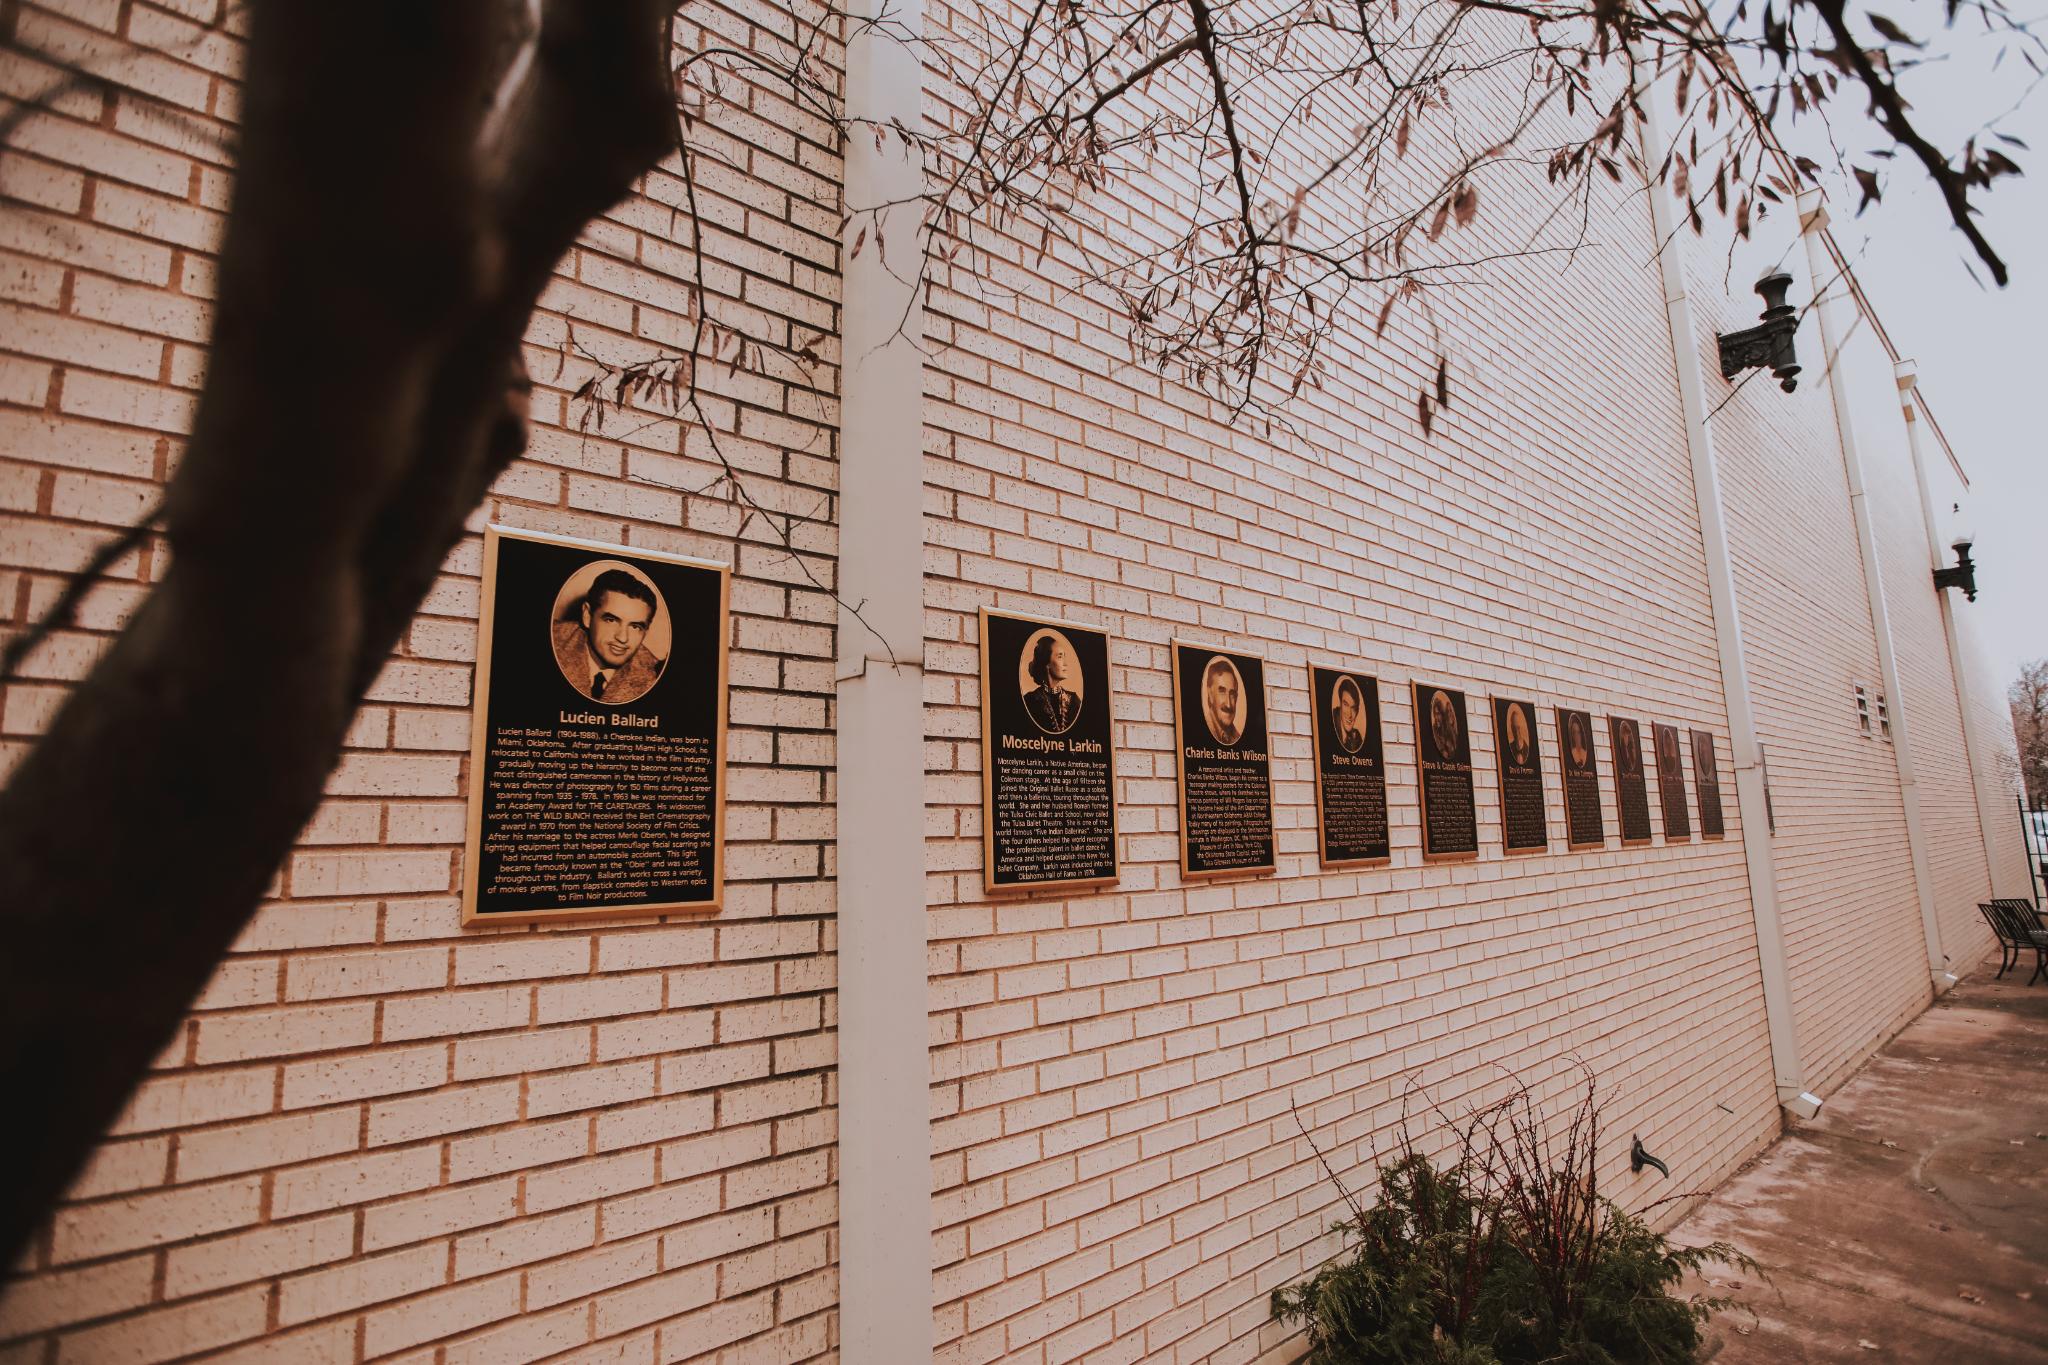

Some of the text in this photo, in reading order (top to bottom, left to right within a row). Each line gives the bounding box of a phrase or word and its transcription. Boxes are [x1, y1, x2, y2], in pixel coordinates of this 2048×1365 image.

[560, 710, 659, 728] Lucien Ballard
[497, 727, 523, 735] Lucien
[525, 728, 551, 736] Ballard
[610, 732, 643, 741] Cherokee
[594, 743, 633, 751] graduating
[657, 744, 672, 753] High
[1002, 734, 1102, 754] Moscelyne Larkin
[542, 750, 578, 758] California
[1186, 747, 1267, 761] Charles Banks Wilson
[1332, 754, 1373, 766] Steve Owens
[494, 874, 540, 883] throughout
